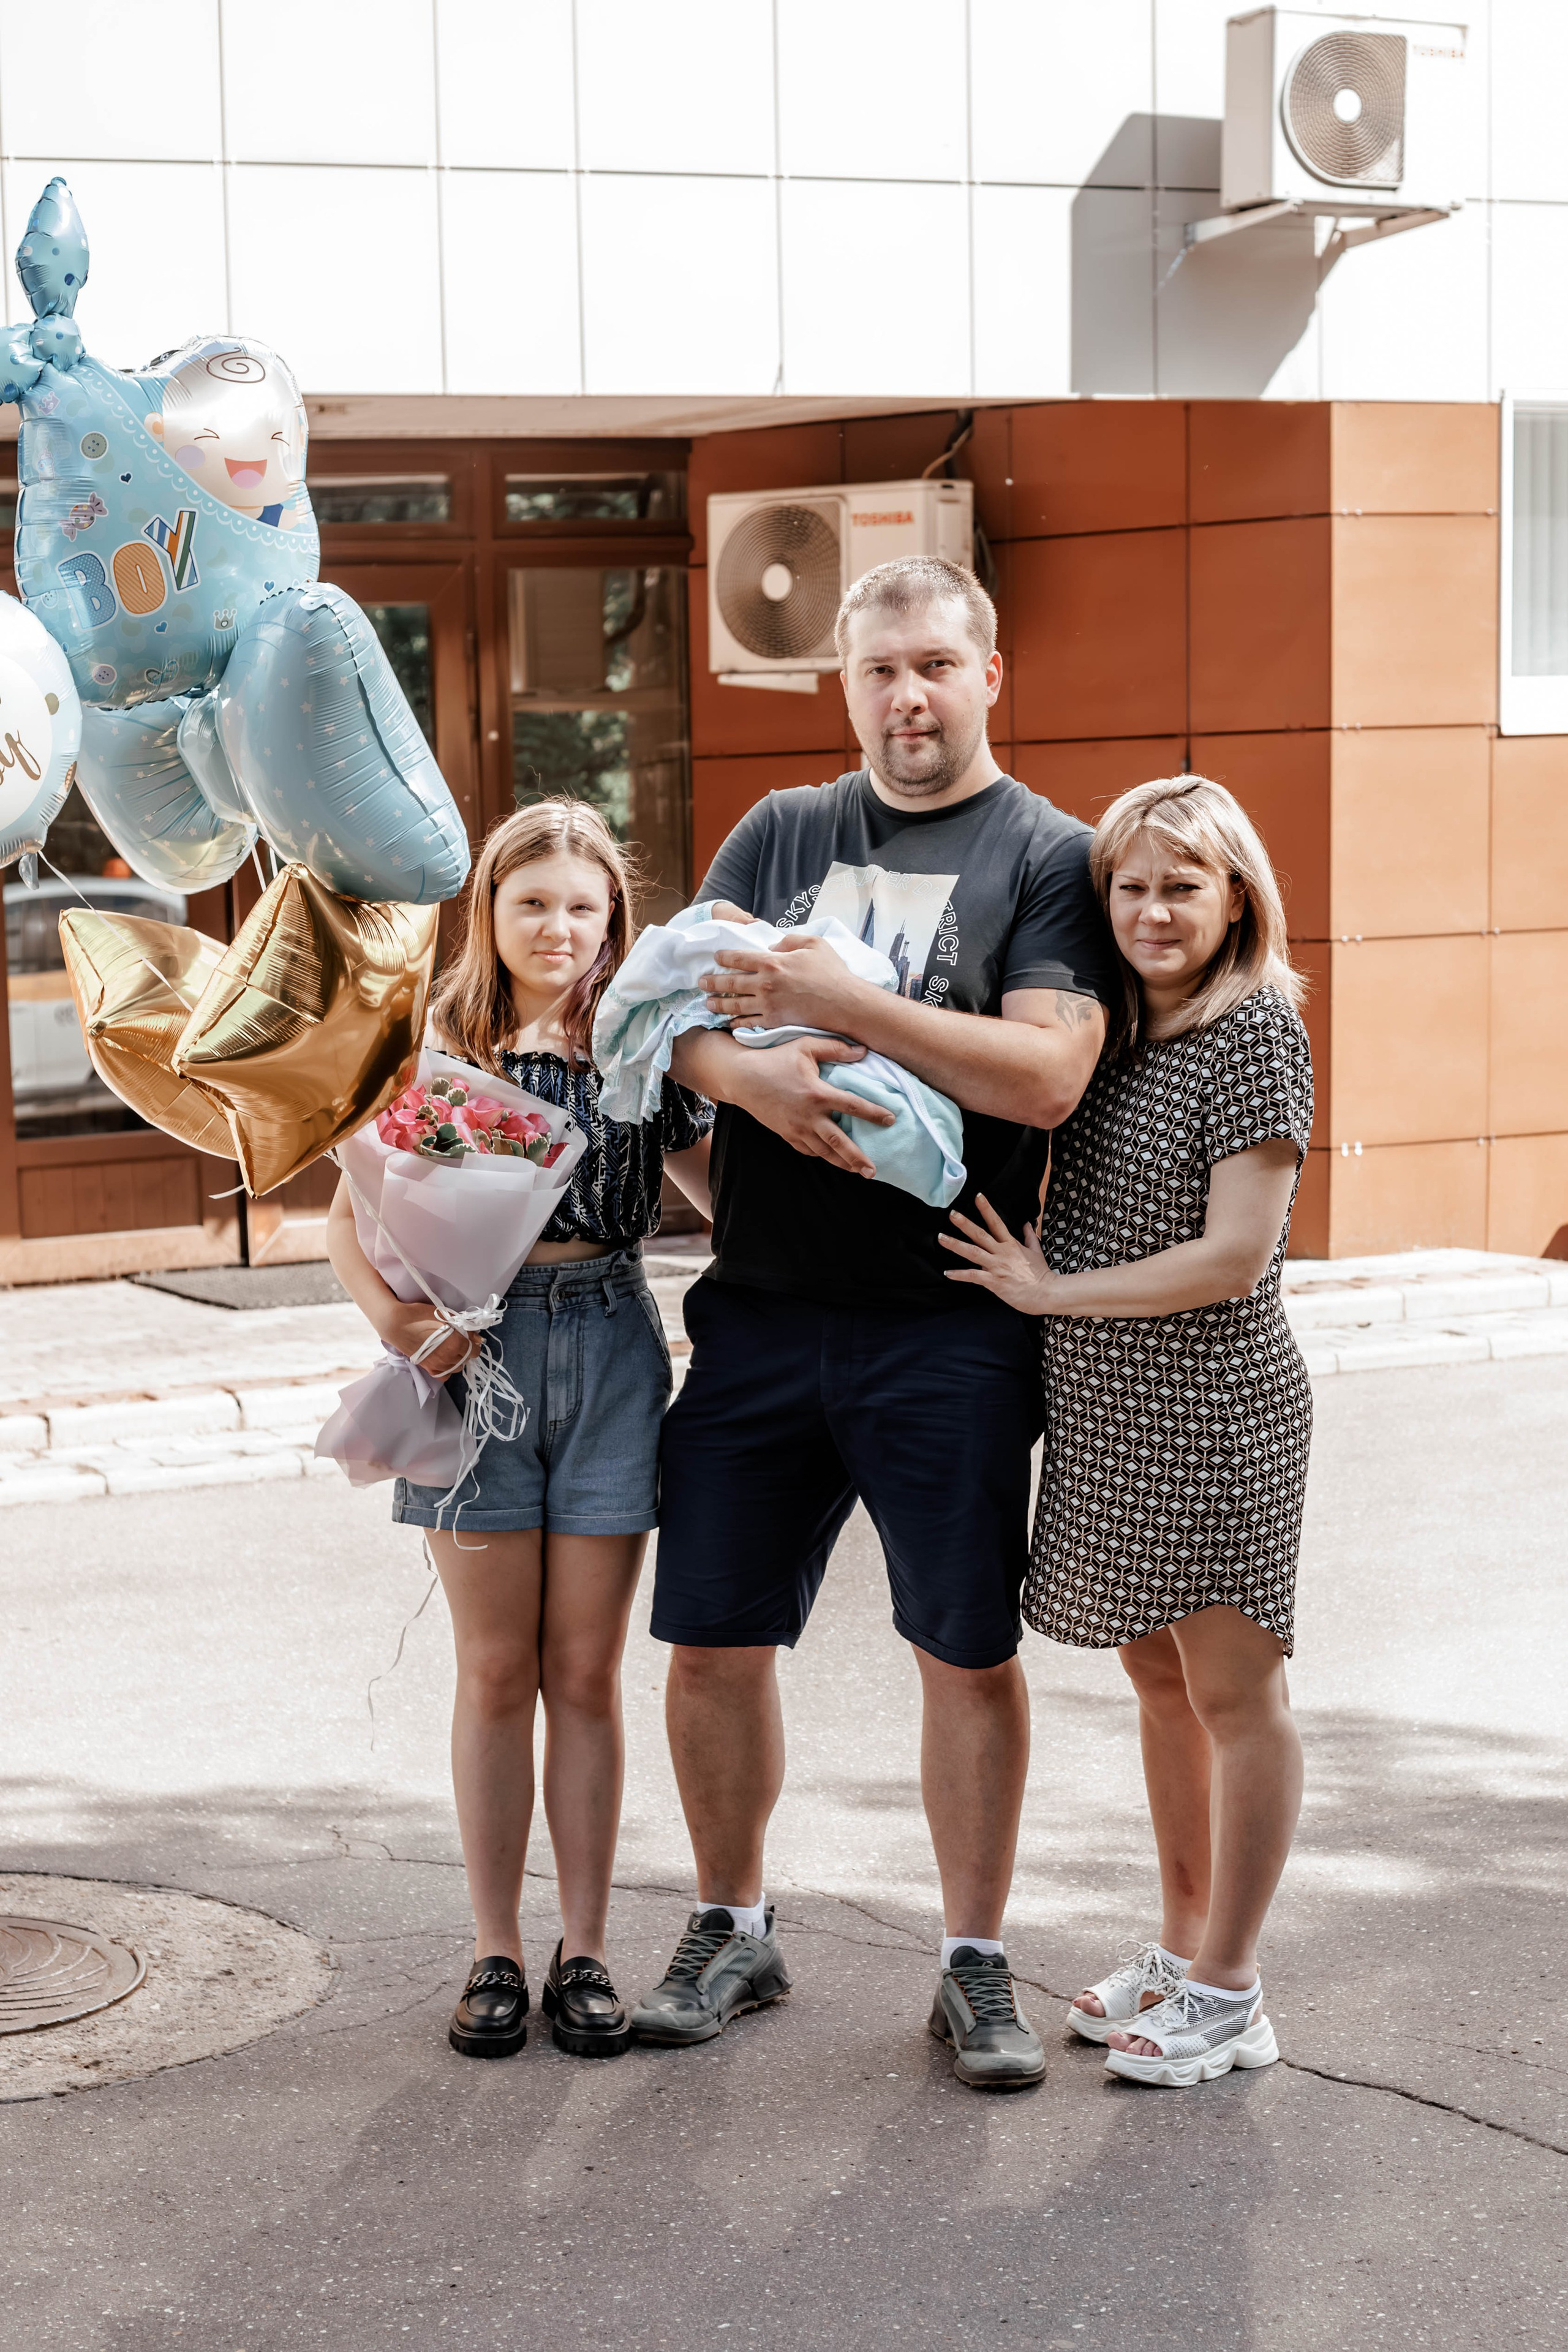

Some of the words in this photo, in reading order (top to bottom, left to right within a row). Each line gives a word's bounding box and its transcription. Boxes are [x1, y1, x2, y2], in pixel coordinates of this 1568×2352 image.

[56, 508, 201, 631] BOY
[851, 511, 915, 527] TOSHIBA
[776, 864, 913, 928] SKYSCRAPER
[913, 879, 959, 966] DISTRICT
